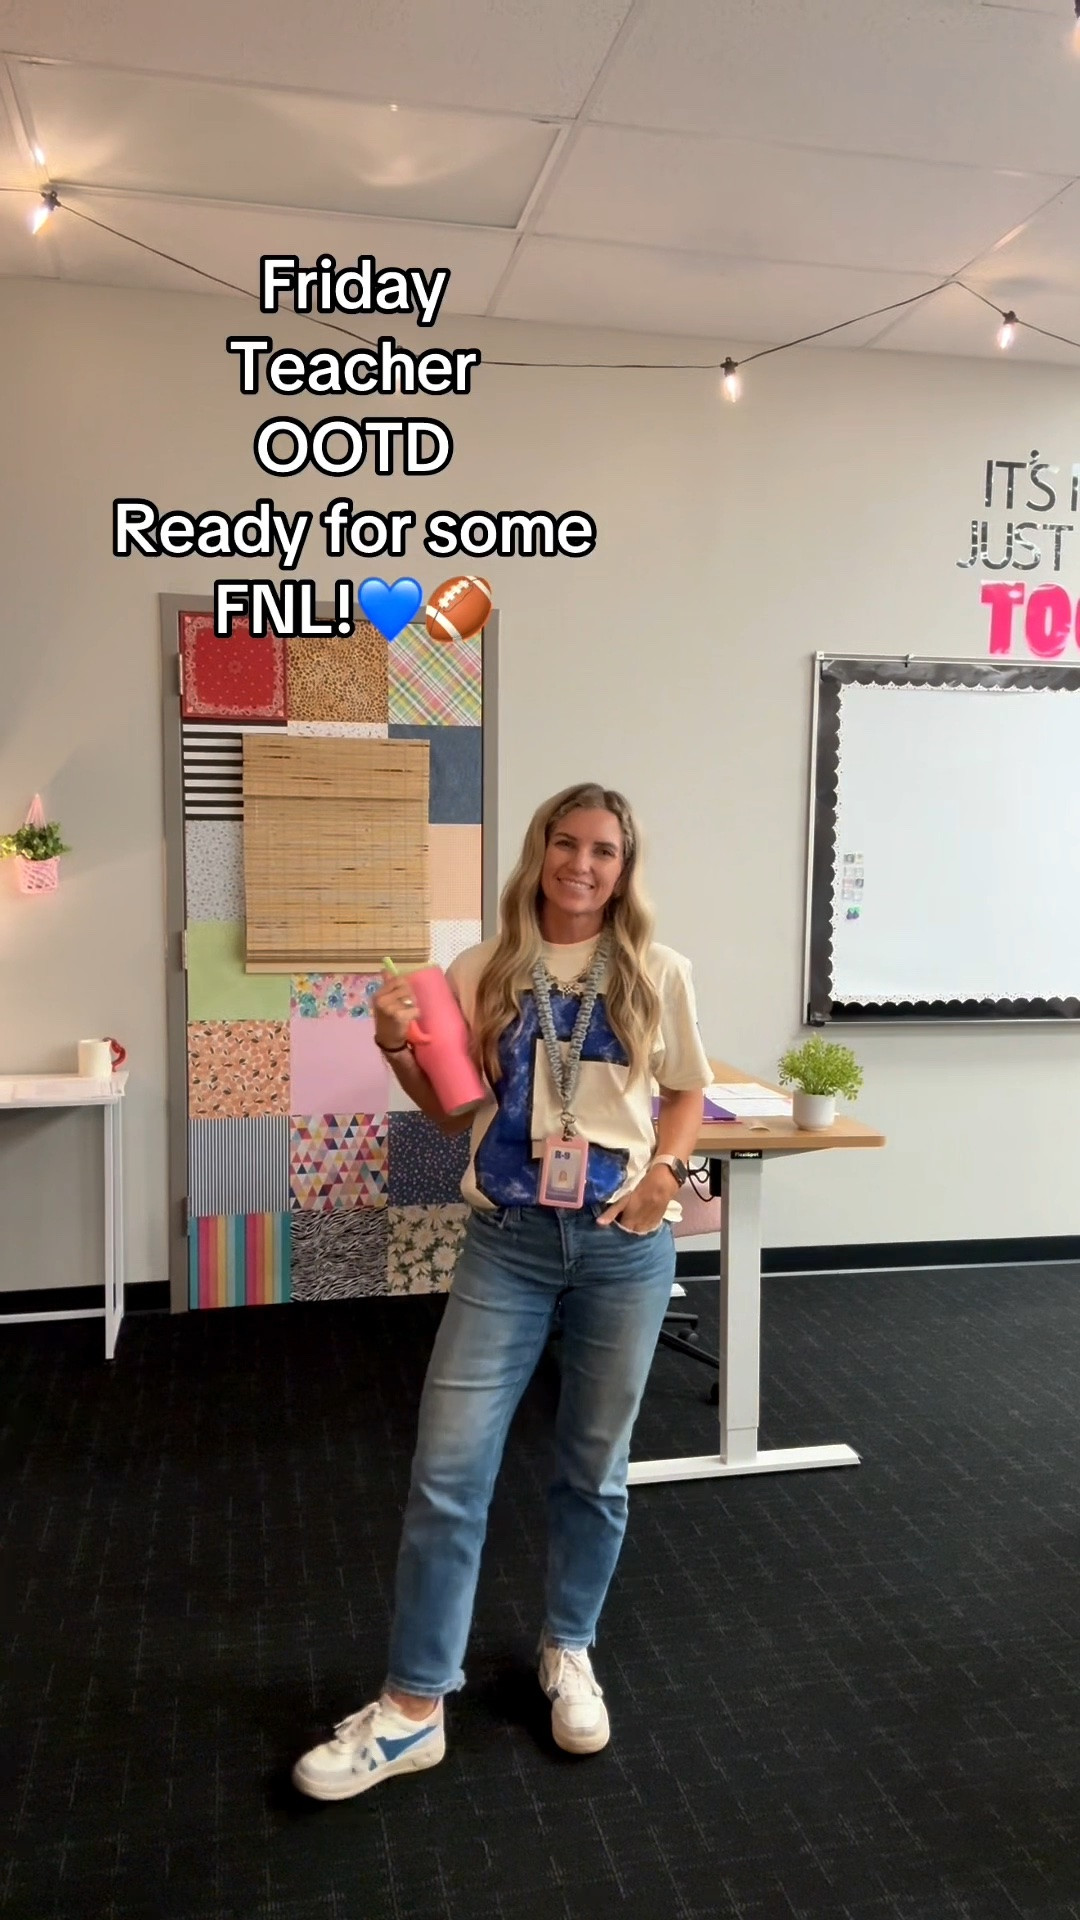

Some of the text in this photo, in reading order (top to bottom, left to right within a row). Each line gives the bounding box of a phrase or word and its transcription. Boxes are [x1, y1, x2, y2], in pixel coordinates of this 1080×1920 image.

[984, 450, 1056, 512] IT'S
[956, 520, 1073, 571] JUST
[980, 581, 1080, 658] TO
